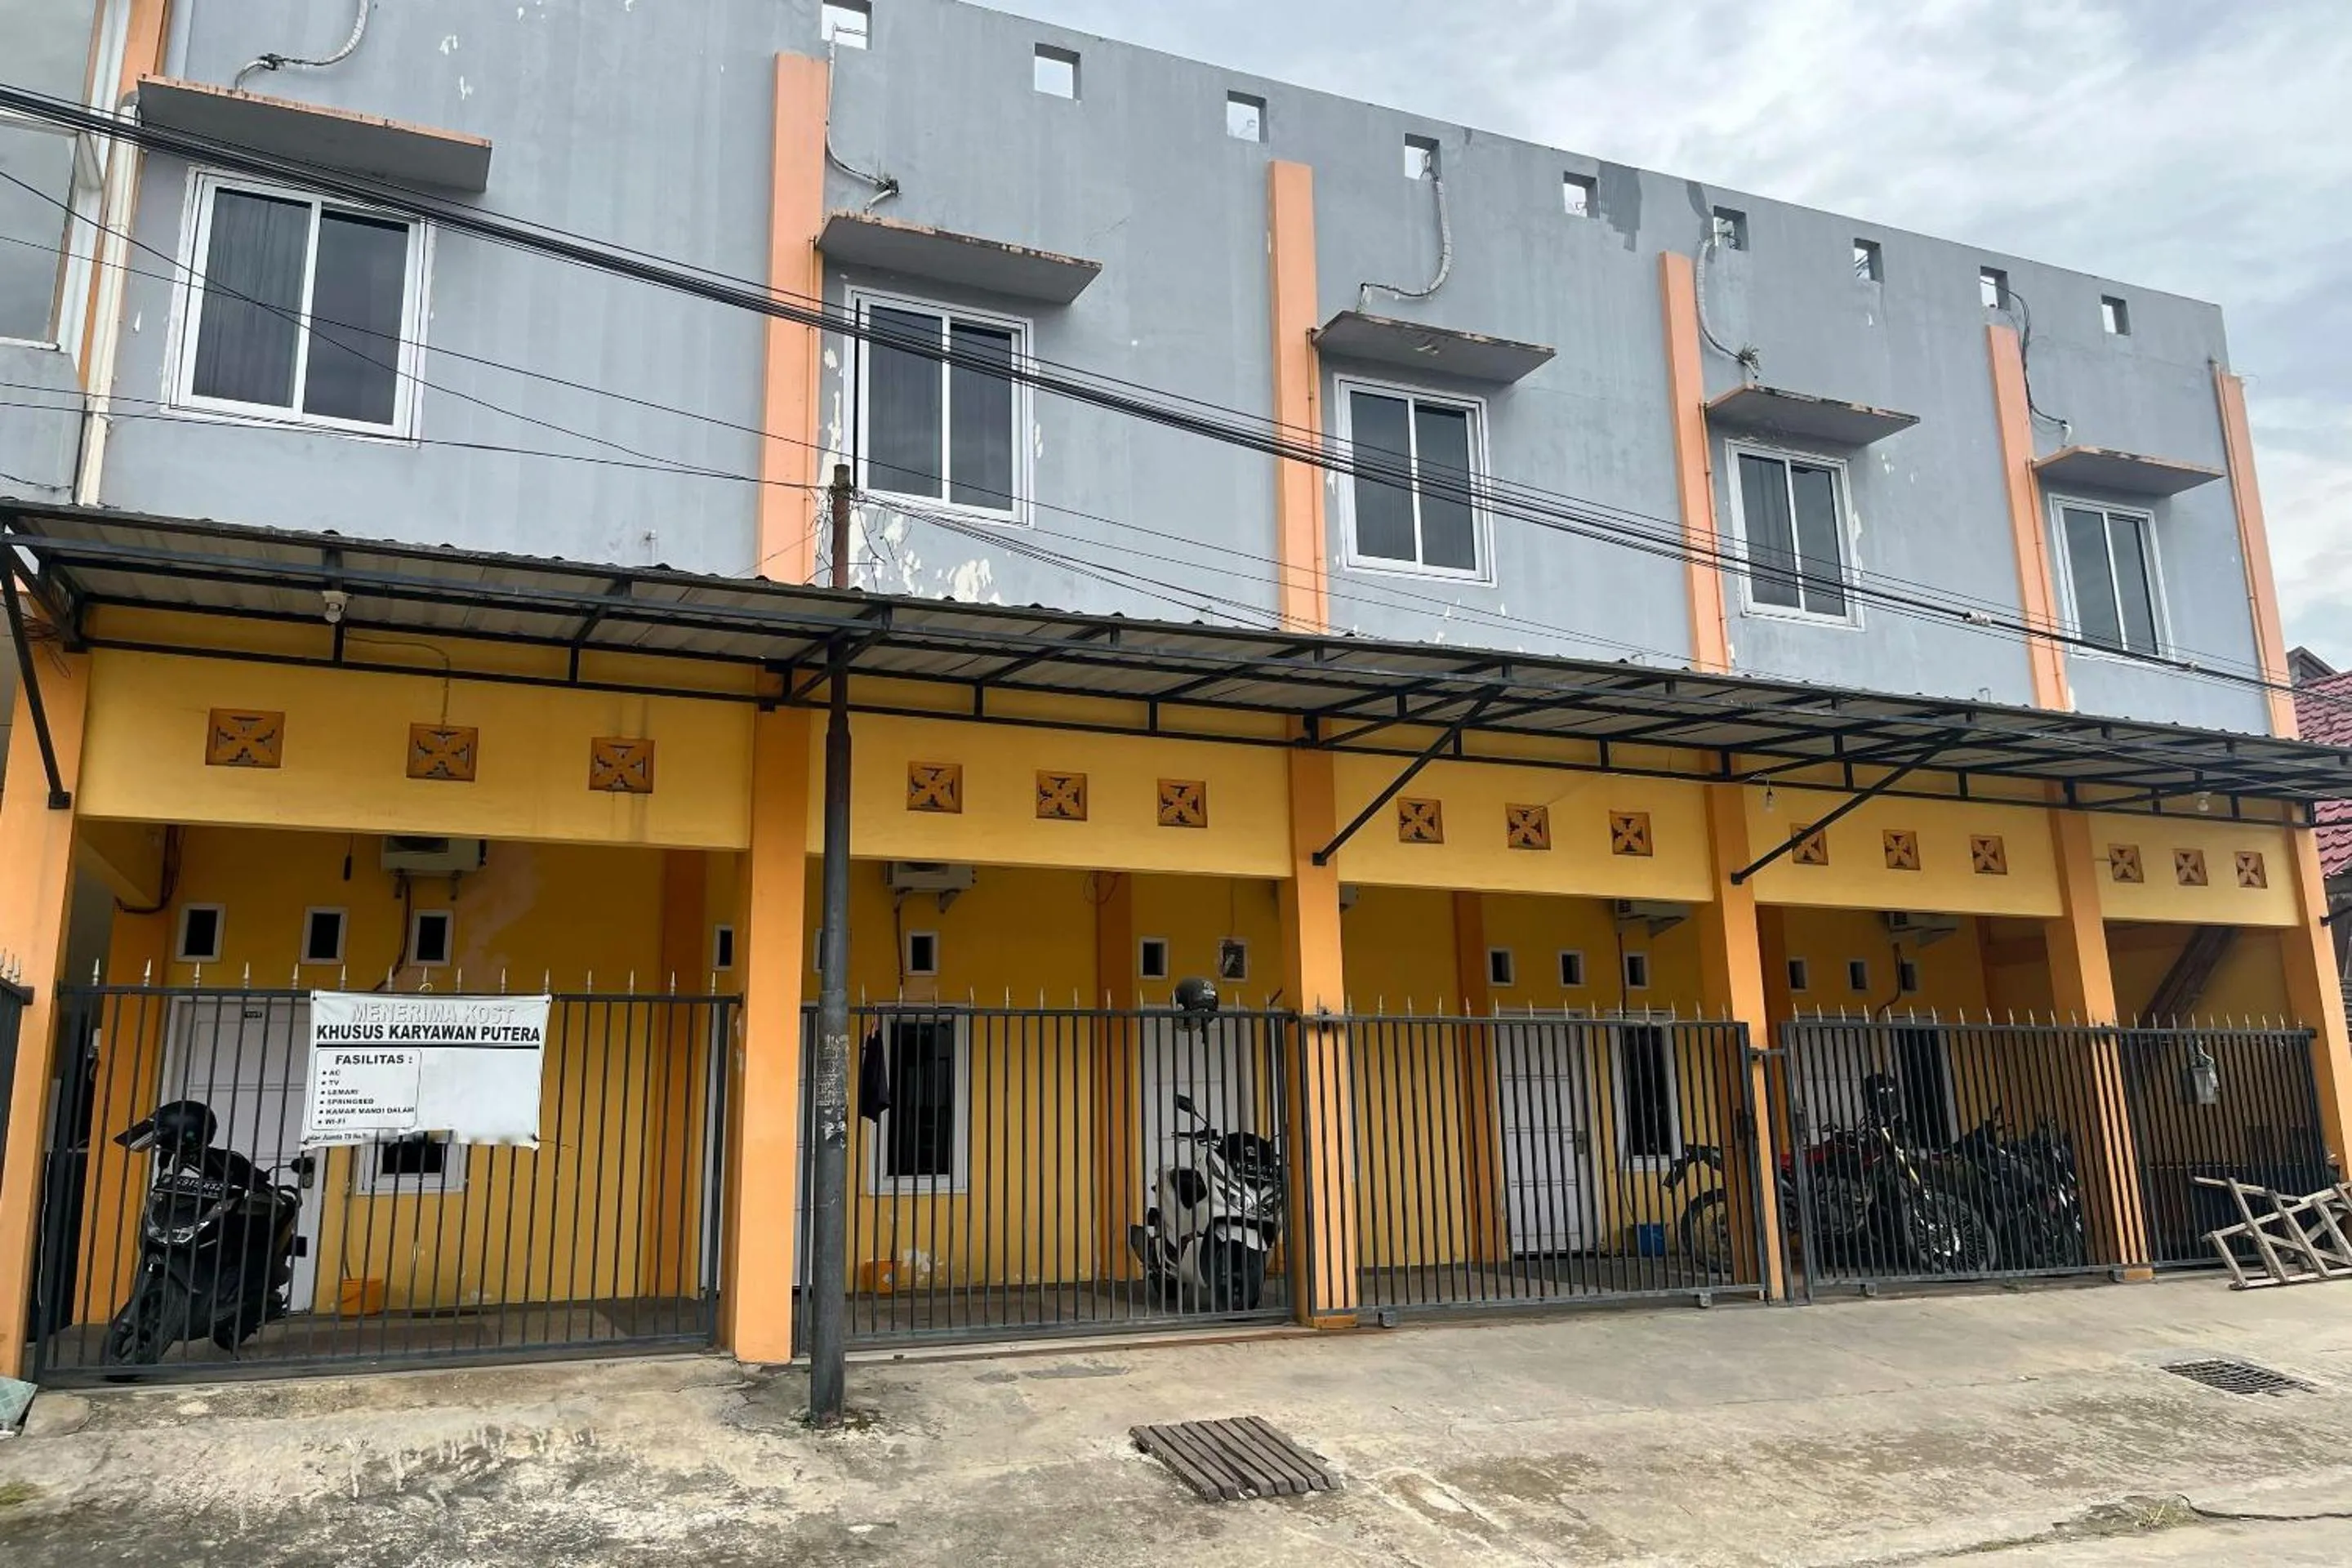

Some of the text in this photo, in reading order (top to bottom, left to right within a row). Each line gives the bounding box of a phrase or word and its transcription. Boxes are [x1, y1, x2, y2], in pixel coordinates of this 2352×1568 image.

[352, 1003, 514, 1025] MENERIMA KOST
[316, 1024, 540, 1041] KHUSUS KARYAWAN PUTERA
[335, 1054, 404, 1065] FASILITAS
